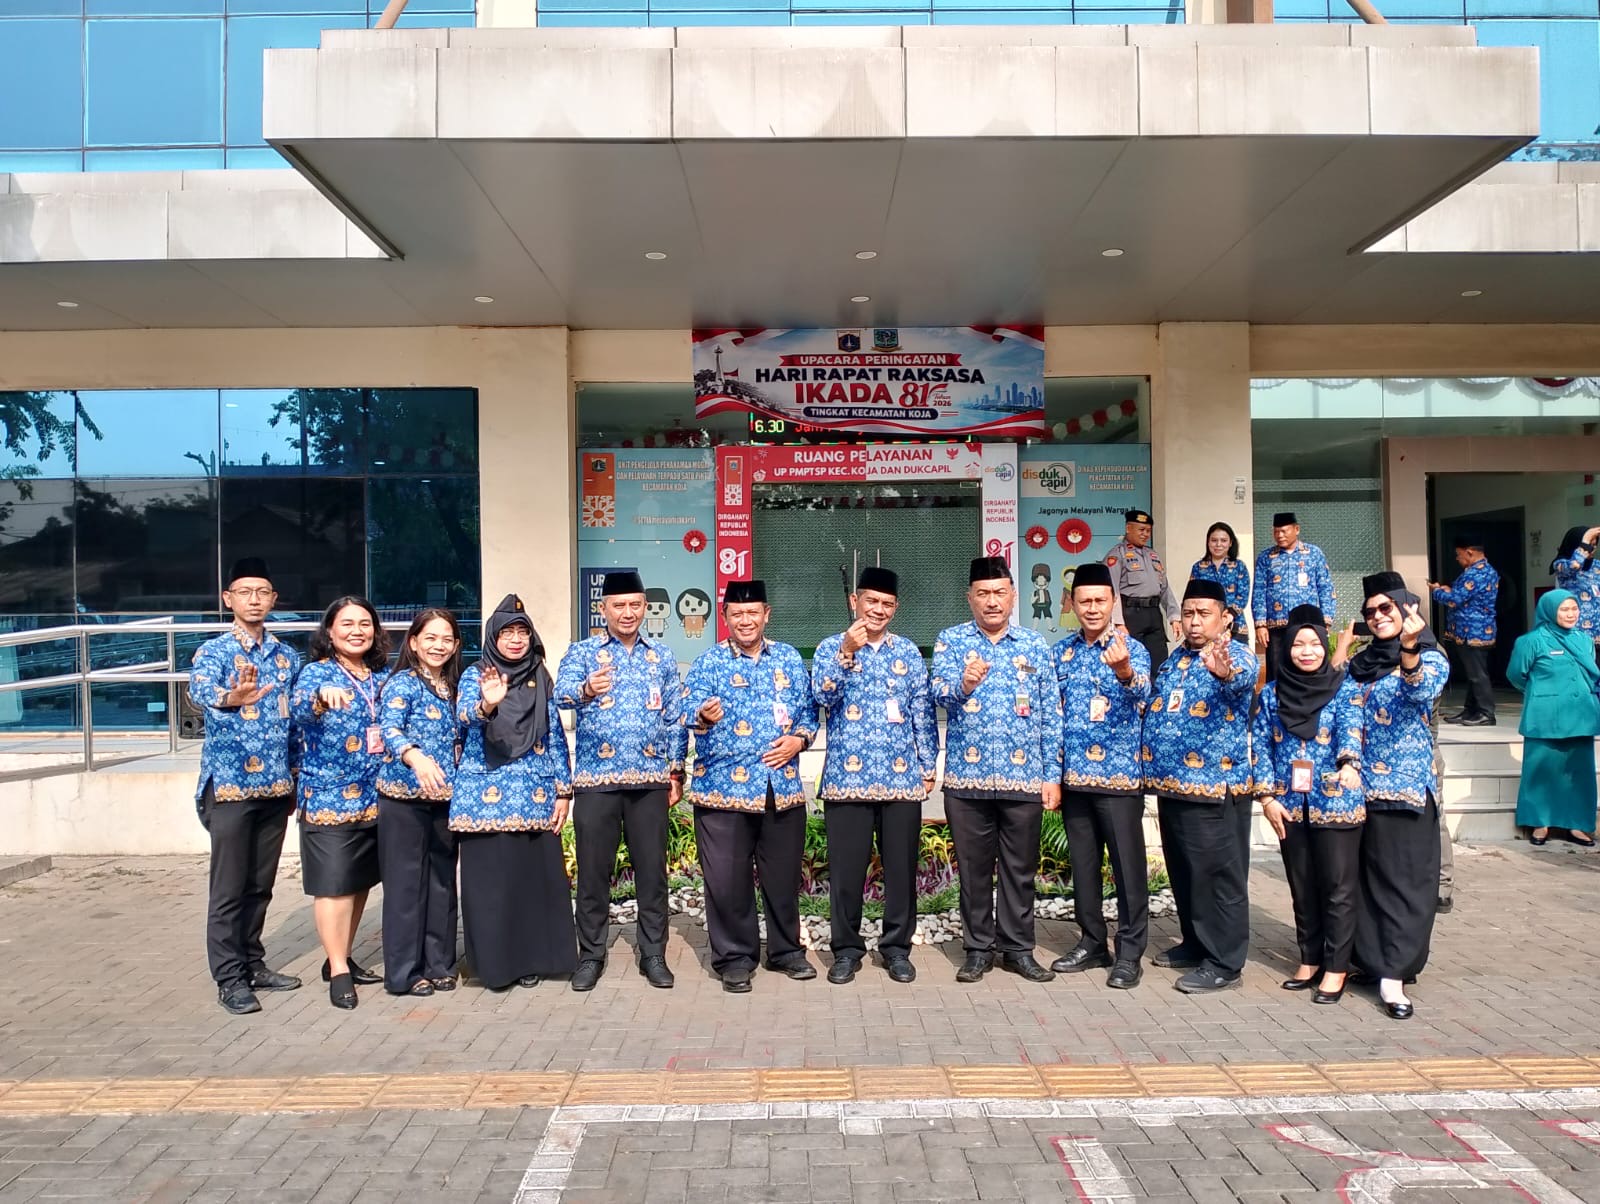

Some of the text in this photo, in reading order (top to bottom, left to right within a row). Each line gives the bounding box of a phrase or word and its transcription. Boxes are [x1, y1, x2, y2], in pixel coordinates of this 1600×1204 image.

[800, 355, 947, 365] UPACARA PERINGATAN
[755, 368, 985, 384] HARI RAPAT RAKSASA
[795, 382, 930, 408] IKADA 81
[810, 408, 932, 418] TINGKAT KECAMATAN KOJA
[794, 449, 933, 463] RUANG PELAYANAN
[774, 465, 952, 477] UP PMPTSP KEC. KOJA DAN DUKCAPIL
[1022, 468, 1060, 479] disduk
[1040, 477, 1067, 490] capil
[1038, 506, 1069, 515] Jagonya
[1071, 506, 1103, 515] Melayani
[719, 547, 750, 578] 81
